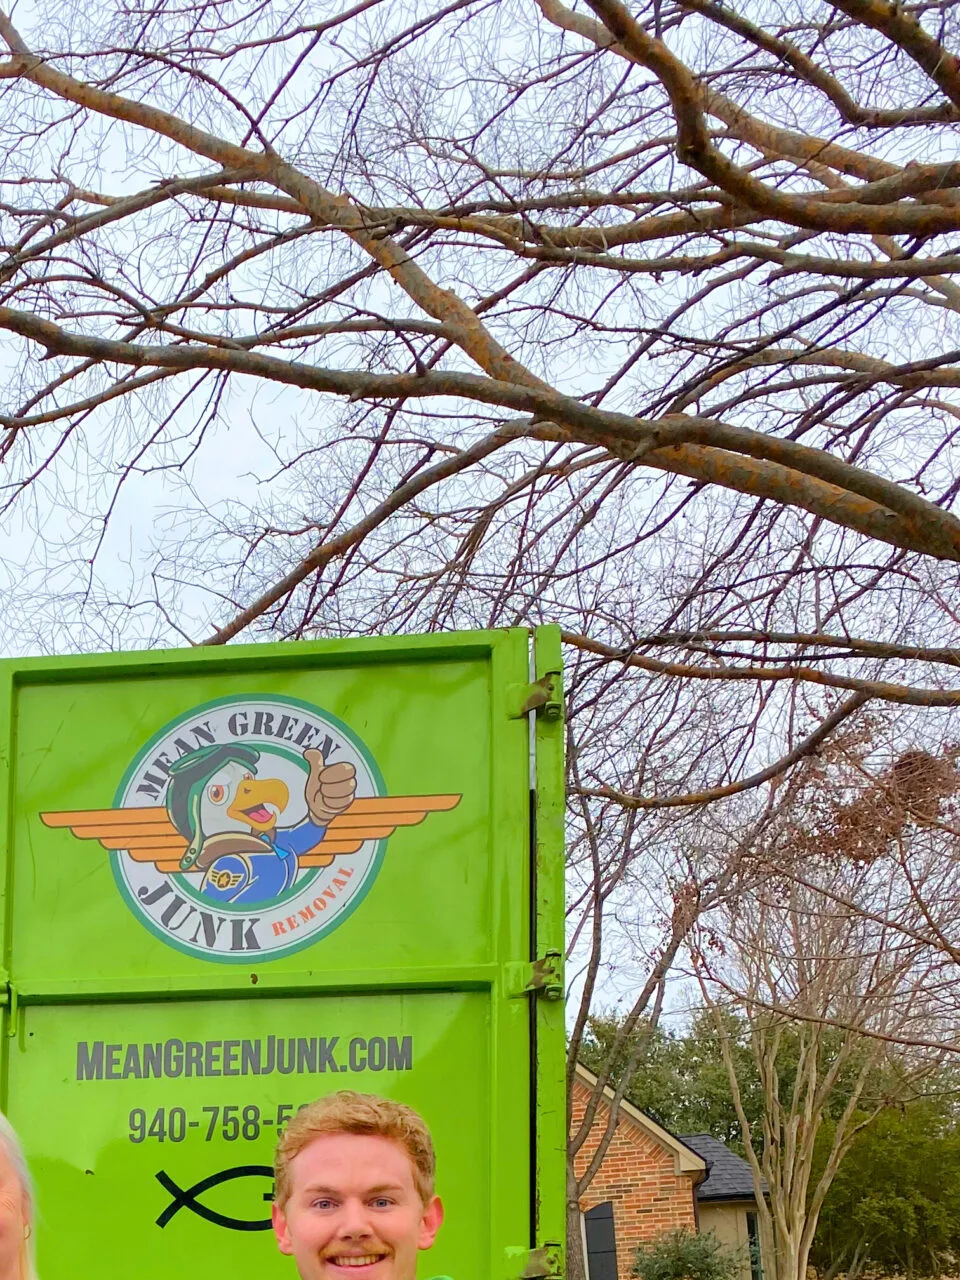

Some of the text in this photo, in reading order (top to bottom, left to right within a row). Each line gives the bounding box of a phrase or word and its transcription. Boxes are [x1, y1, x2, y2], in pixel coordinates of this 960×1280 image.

[136, 711, 341, 801] MEAN GREEN
[138, 866, 355, 951] JUNK REMOVAL
[128, 1104, 309, 1143] 940-758-5
